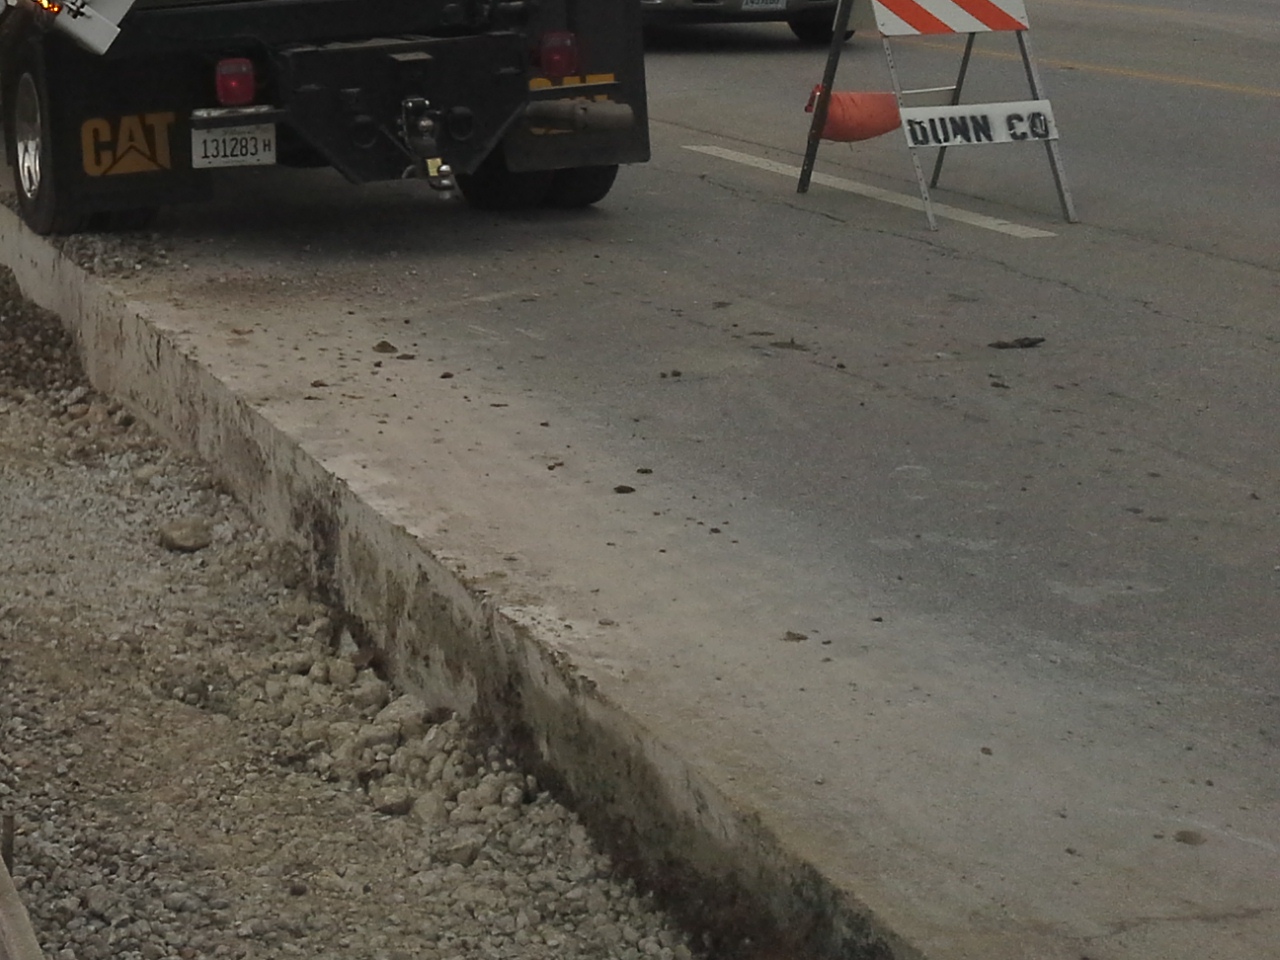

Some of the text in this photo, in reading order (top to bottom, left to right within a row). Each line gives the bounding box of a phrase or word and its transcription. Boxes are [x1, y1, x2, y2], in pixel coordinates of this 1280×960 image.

[81, 112, 175, 177] CAT
[907, 112, 1050, 145] DUNN CO
[201, 136, 272, 159] 131283 H
